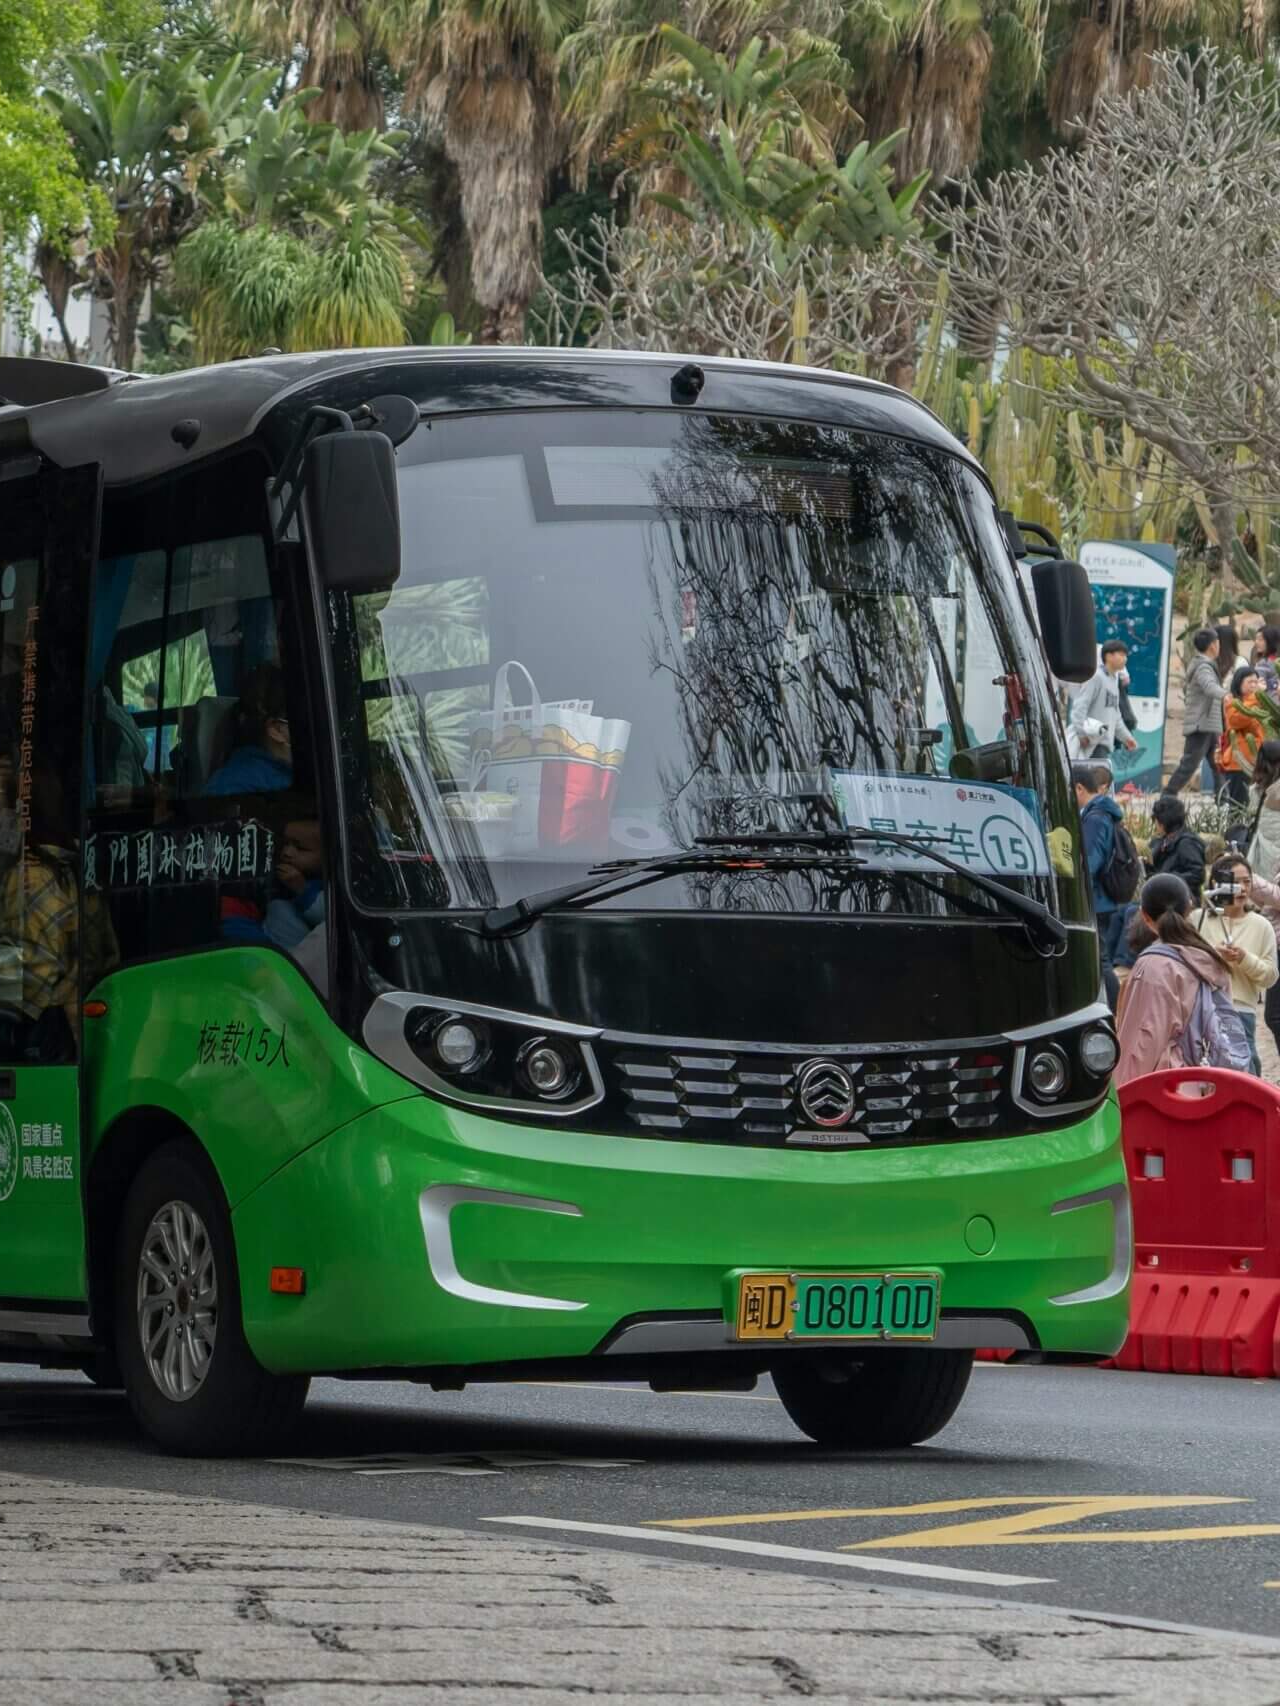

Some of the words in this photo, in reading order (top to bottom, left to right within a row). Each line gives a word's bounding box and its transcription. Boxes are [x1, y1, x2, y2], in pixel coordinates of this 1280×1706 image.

[197, 1020, 289, 1067] 核载15人
[21, 1122, 64, 1147] 国家重点
[22, 1155, 74, 1179] 风景名胜区
[743, 1285, 787, 1330] 闽D
[804, 1285, 934, 1330] 08010D
